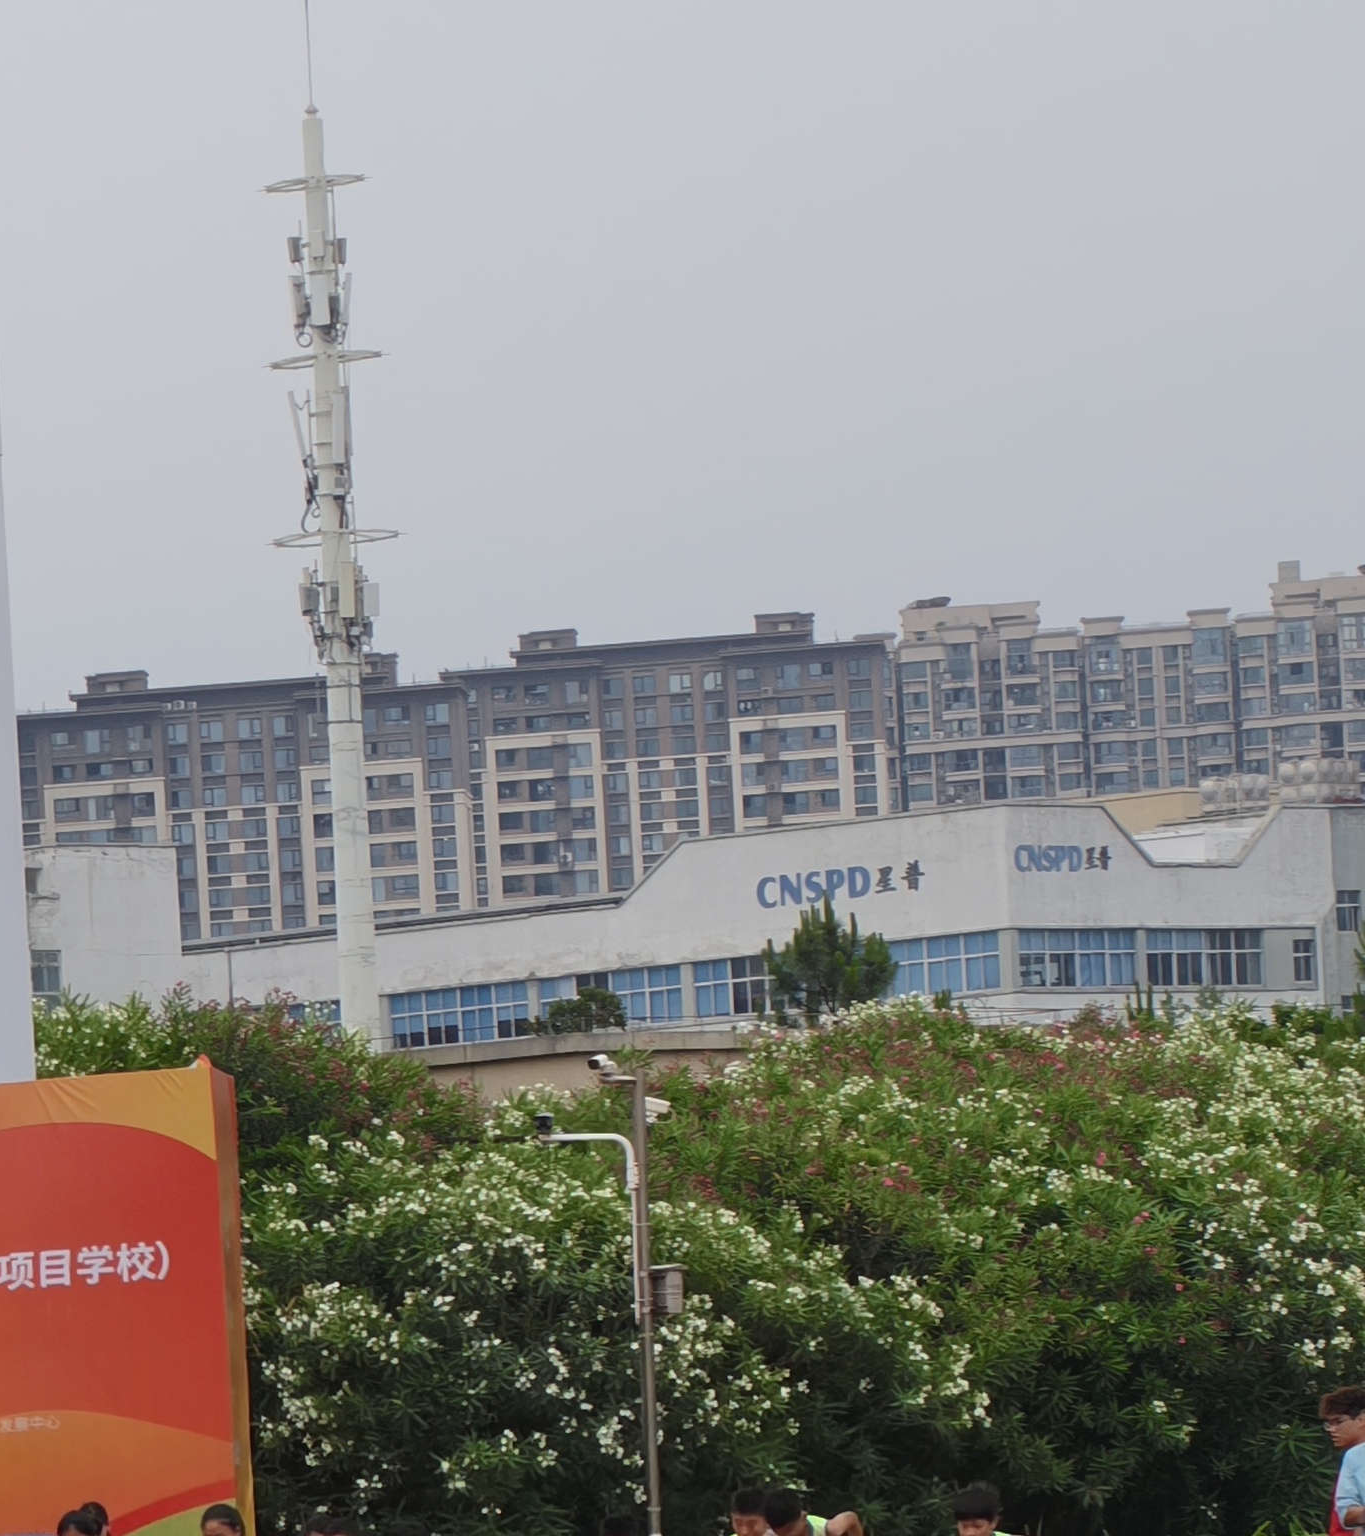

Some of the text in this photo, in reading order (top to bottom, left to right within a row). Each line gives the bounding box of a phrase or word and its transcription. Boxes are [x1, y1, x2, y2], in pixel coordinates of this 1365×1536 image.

[1014, 845, 1083, 872] CNSPD
[756, 860, 925, 909] CNSPD 星普
